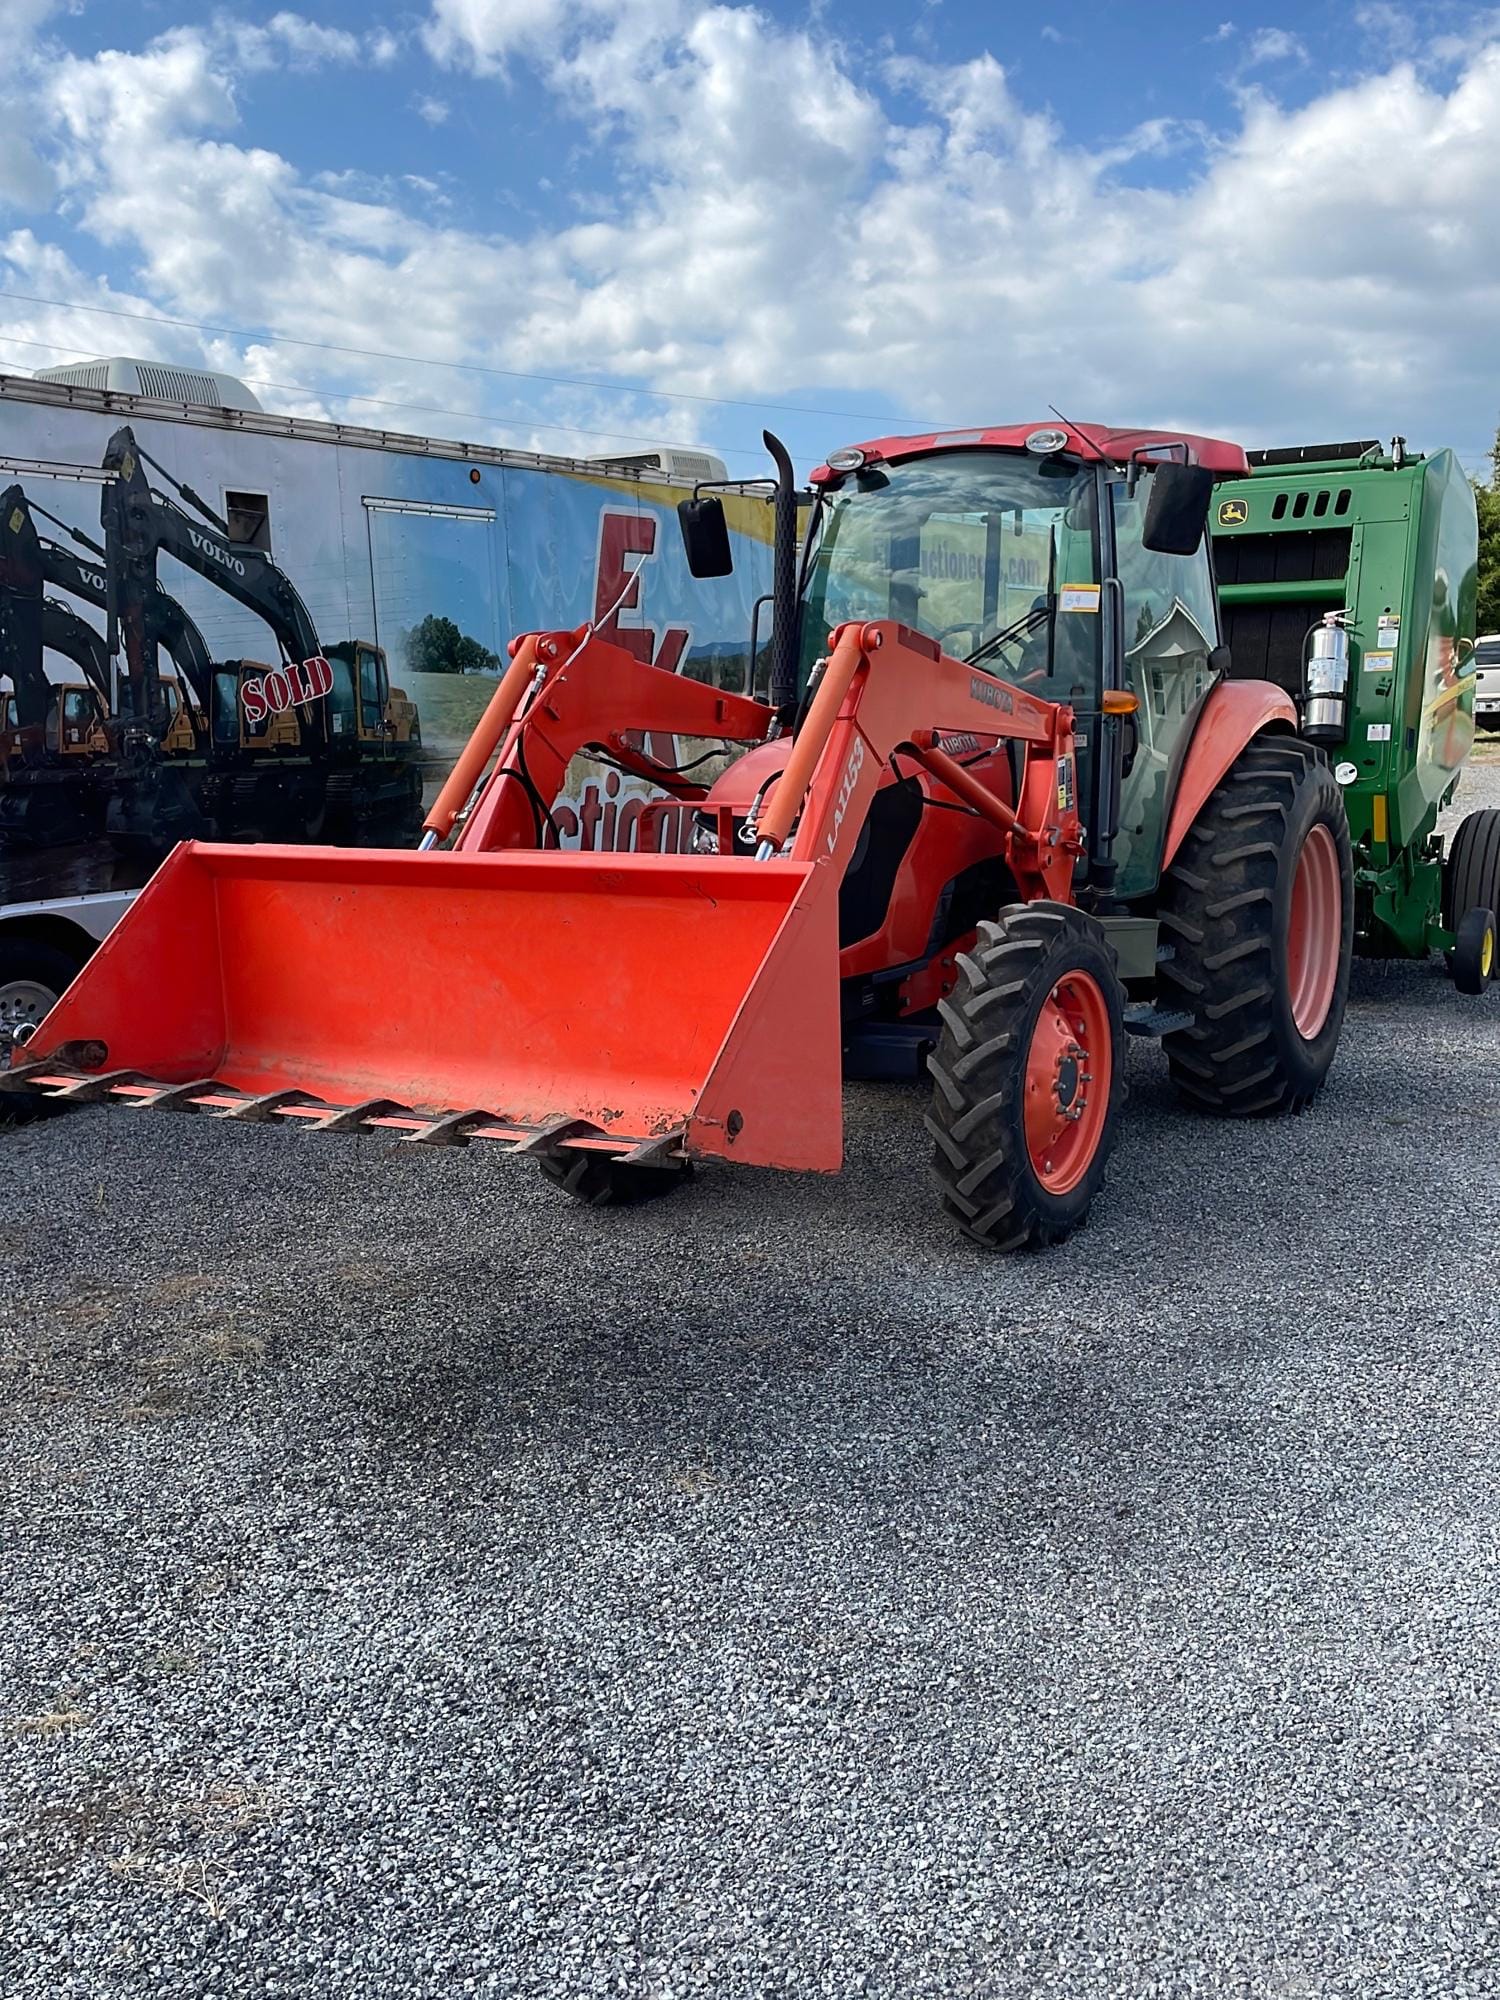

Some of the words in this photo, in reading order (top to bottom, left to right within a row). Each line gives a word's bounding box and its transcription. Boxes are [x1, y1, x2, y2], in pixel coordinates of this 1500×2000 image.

[187, 527, 246, 577] VOLVO
[77, 566, 107, 592] VO
[241, 656, 333, 723] SOLD
[970, 676, 1013, 716] KUBOTA
[938, 733, 980, 757] KUBOTA
[827, 735, 864, 855] LA1153
